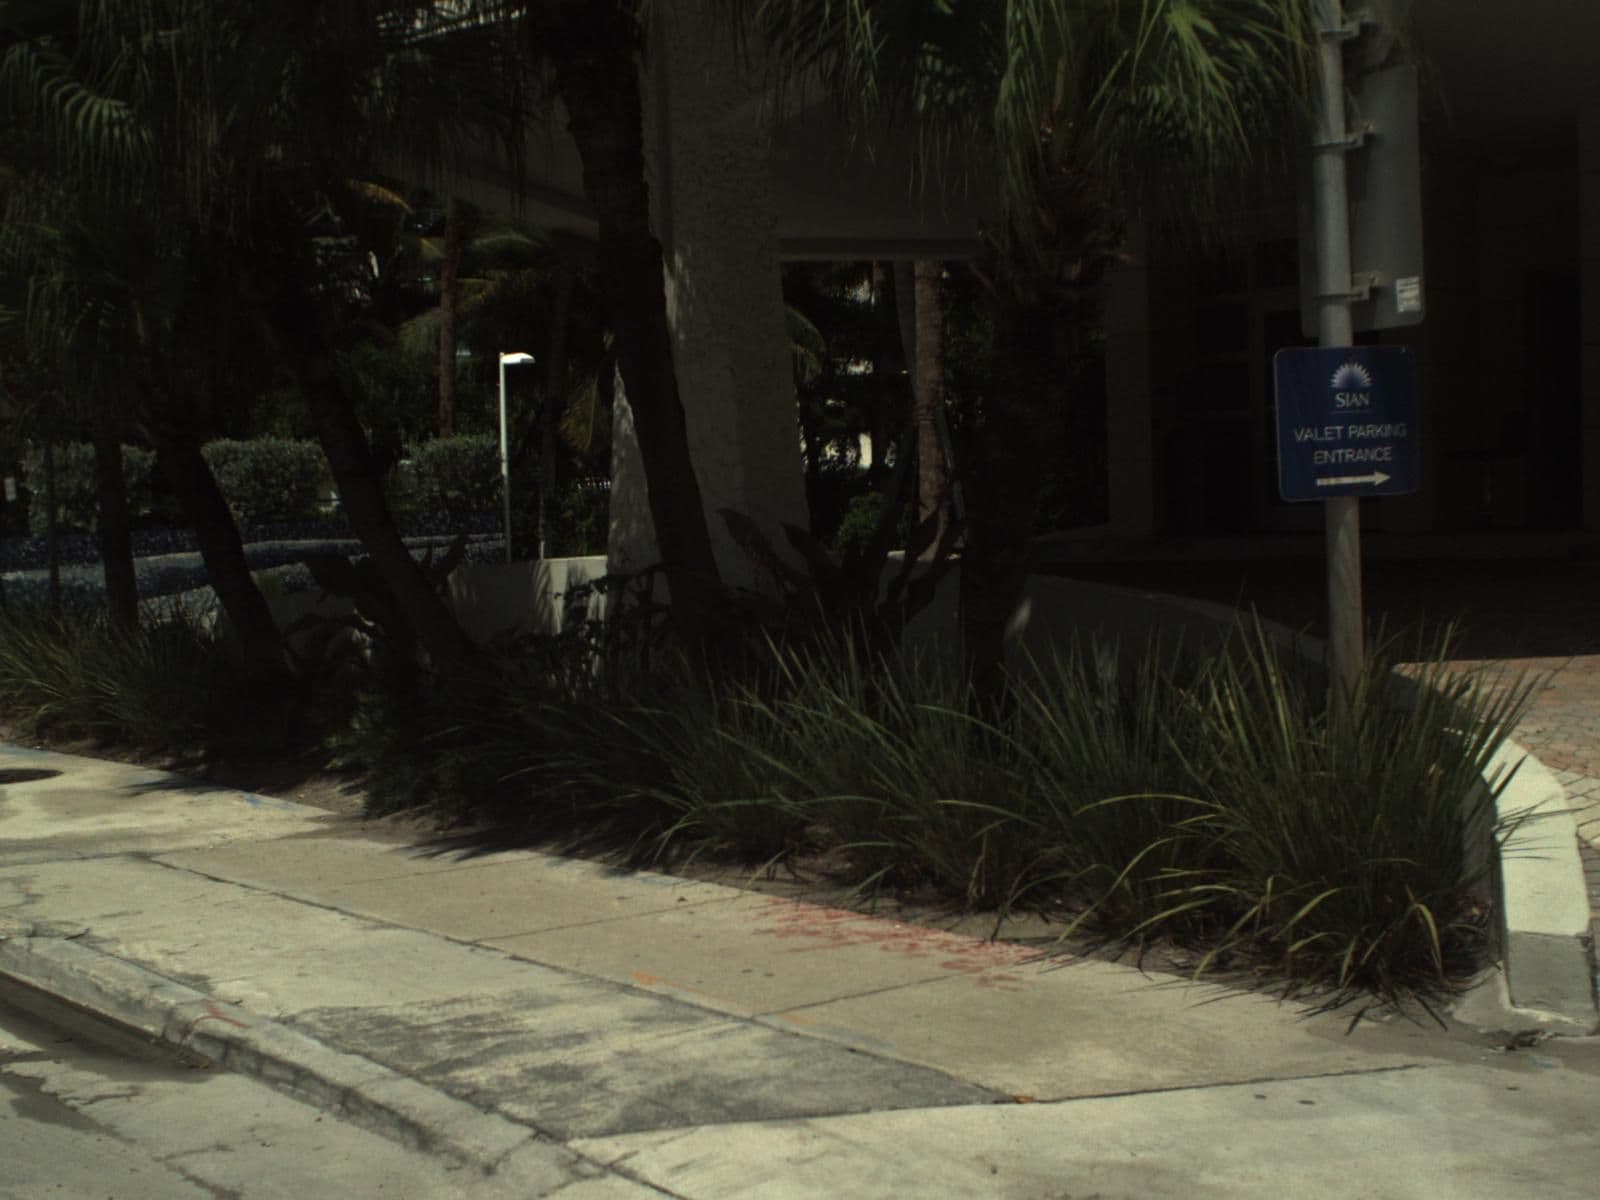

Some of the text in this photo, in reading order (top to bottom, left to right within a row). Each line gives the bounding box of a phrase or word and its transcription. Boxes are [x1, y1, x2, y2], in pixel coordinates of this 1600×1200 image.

[1335, 392, 1369, 408] SIAN
[1294, 423, 1407, 443] VALET PARKING
[1313, 447, 1392, 464] ENTRANCE
